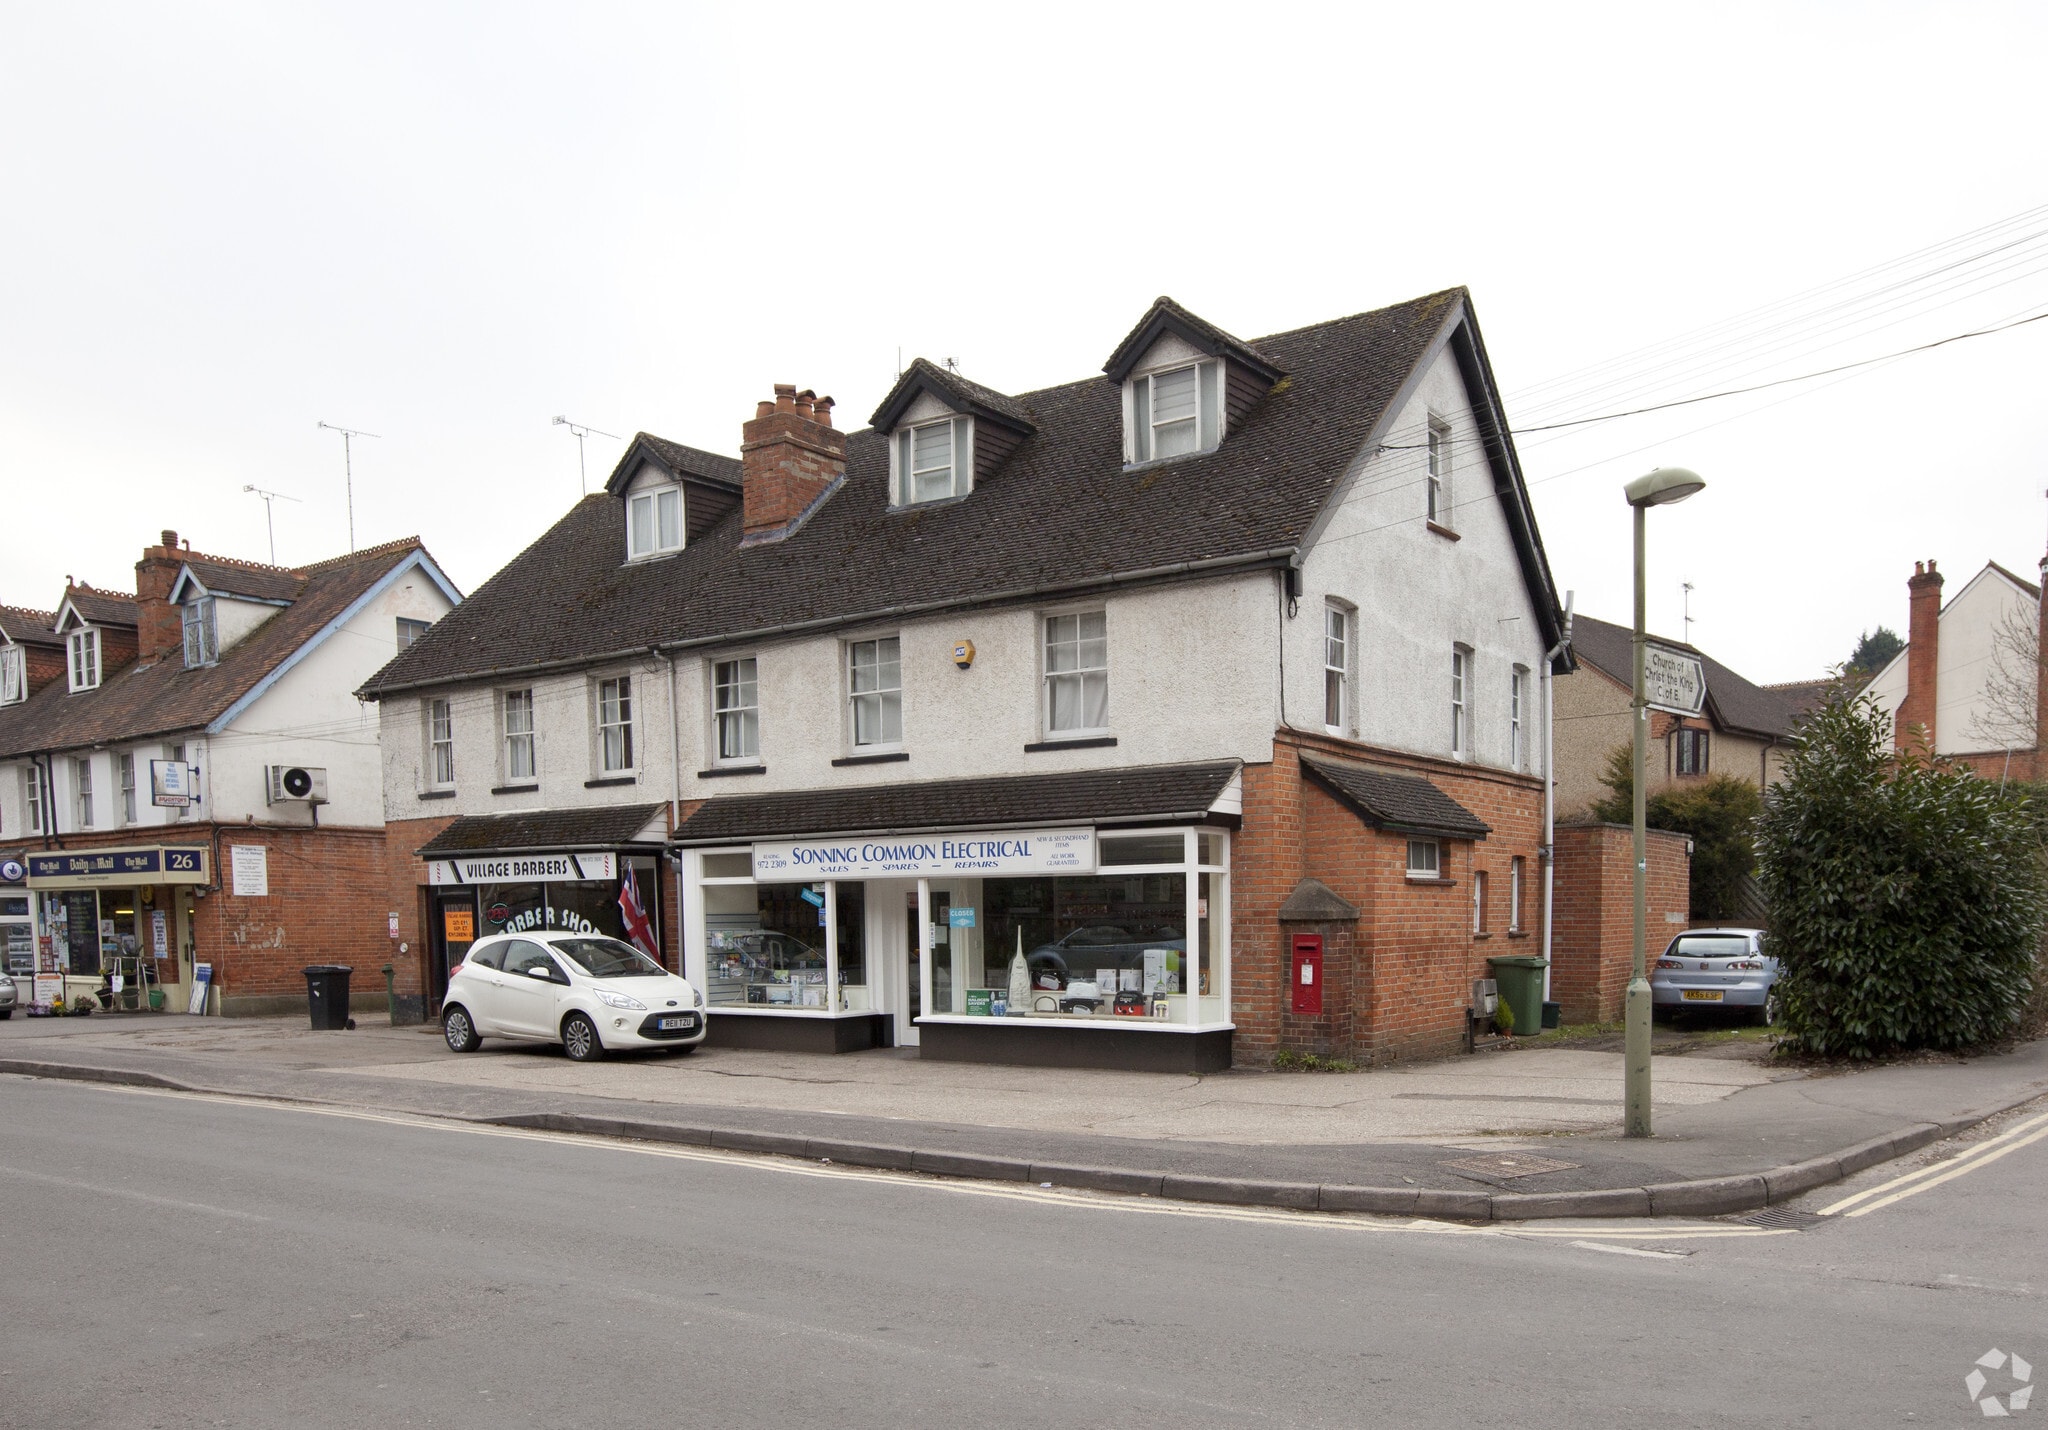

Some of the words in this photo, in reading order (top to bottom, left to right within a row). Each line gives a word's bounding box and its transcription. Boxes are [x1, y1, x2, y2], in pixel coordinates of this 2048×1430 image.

[1652, 654, 1675, 670] Church
[1677, 662, 1684, 672] of
[1646, 666, 1664, 683] Christ
[1667, 672, 1677, 686] the
[1680, 675, 1693, 692] King
[1666, 688, 1672, 700] of
[1674, 689, 1680, 701] E.
[792, 847, 857, 865] SONNING
[862, 844, 936, 862] COMMON
[942, 840, 1032, 859] ELECTRICAL
[50, 862, 60, 870] Mail
[70, 858, 88, 873] Daily
[96, 856, 114, 868] Mail
[125, 857, 135, 866] The
[136, 857, 148, 865] Mail
[172, 854, 193, 868] 26
[770, 860, 787, 868] 2309
[954, 860, 999, 869] REPAIRS
[467, 862, 509, 878] VILLAGE
[514, 860, 568, 876] BARBERS
[487, 908, 509, 920] OPEN
